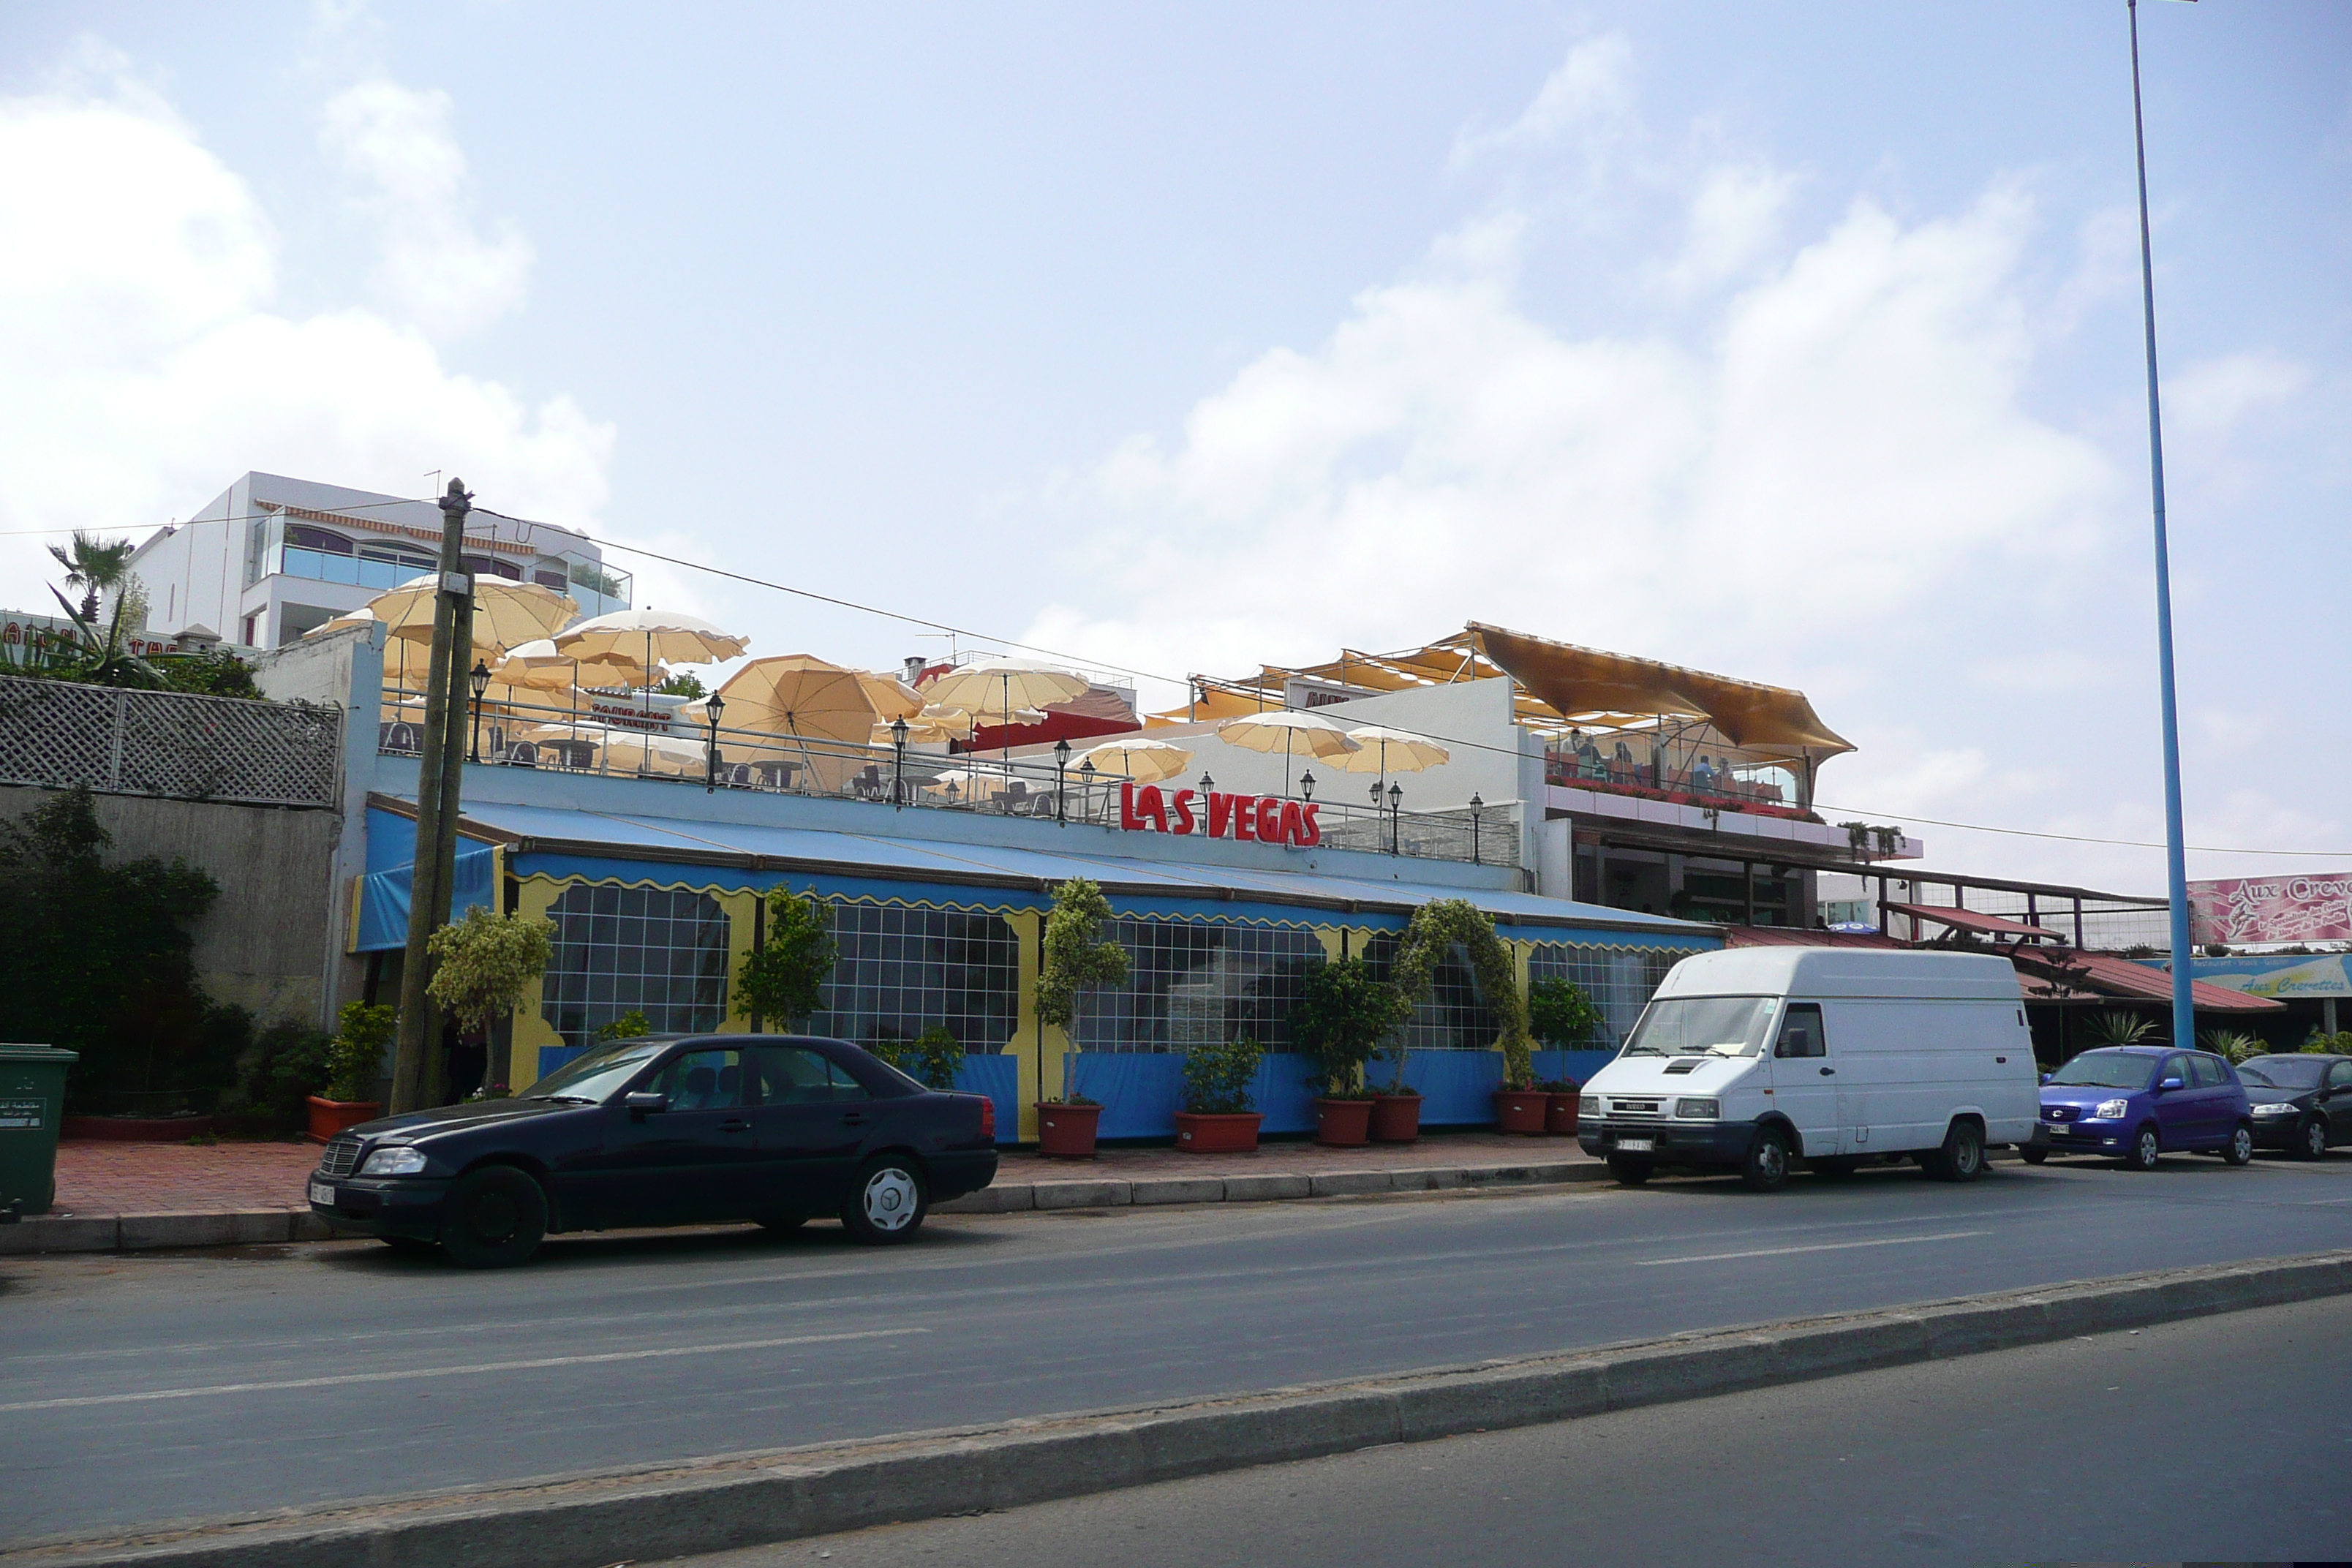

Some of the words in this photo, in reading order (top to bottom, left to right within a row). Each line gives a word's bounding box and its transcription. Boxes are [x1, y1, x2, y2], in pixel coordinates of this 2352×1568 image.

[1120, 781, 1194, 835] LAS
[1207, 791, 1321, 847] VEGAS
[2229, 879, 2279, 905] Aux
[2193, 959, 2231, 967] Restaurant
[2239, 977, 2271, 992] Aux
[2277, 977, 2345, 993] Crevettes
